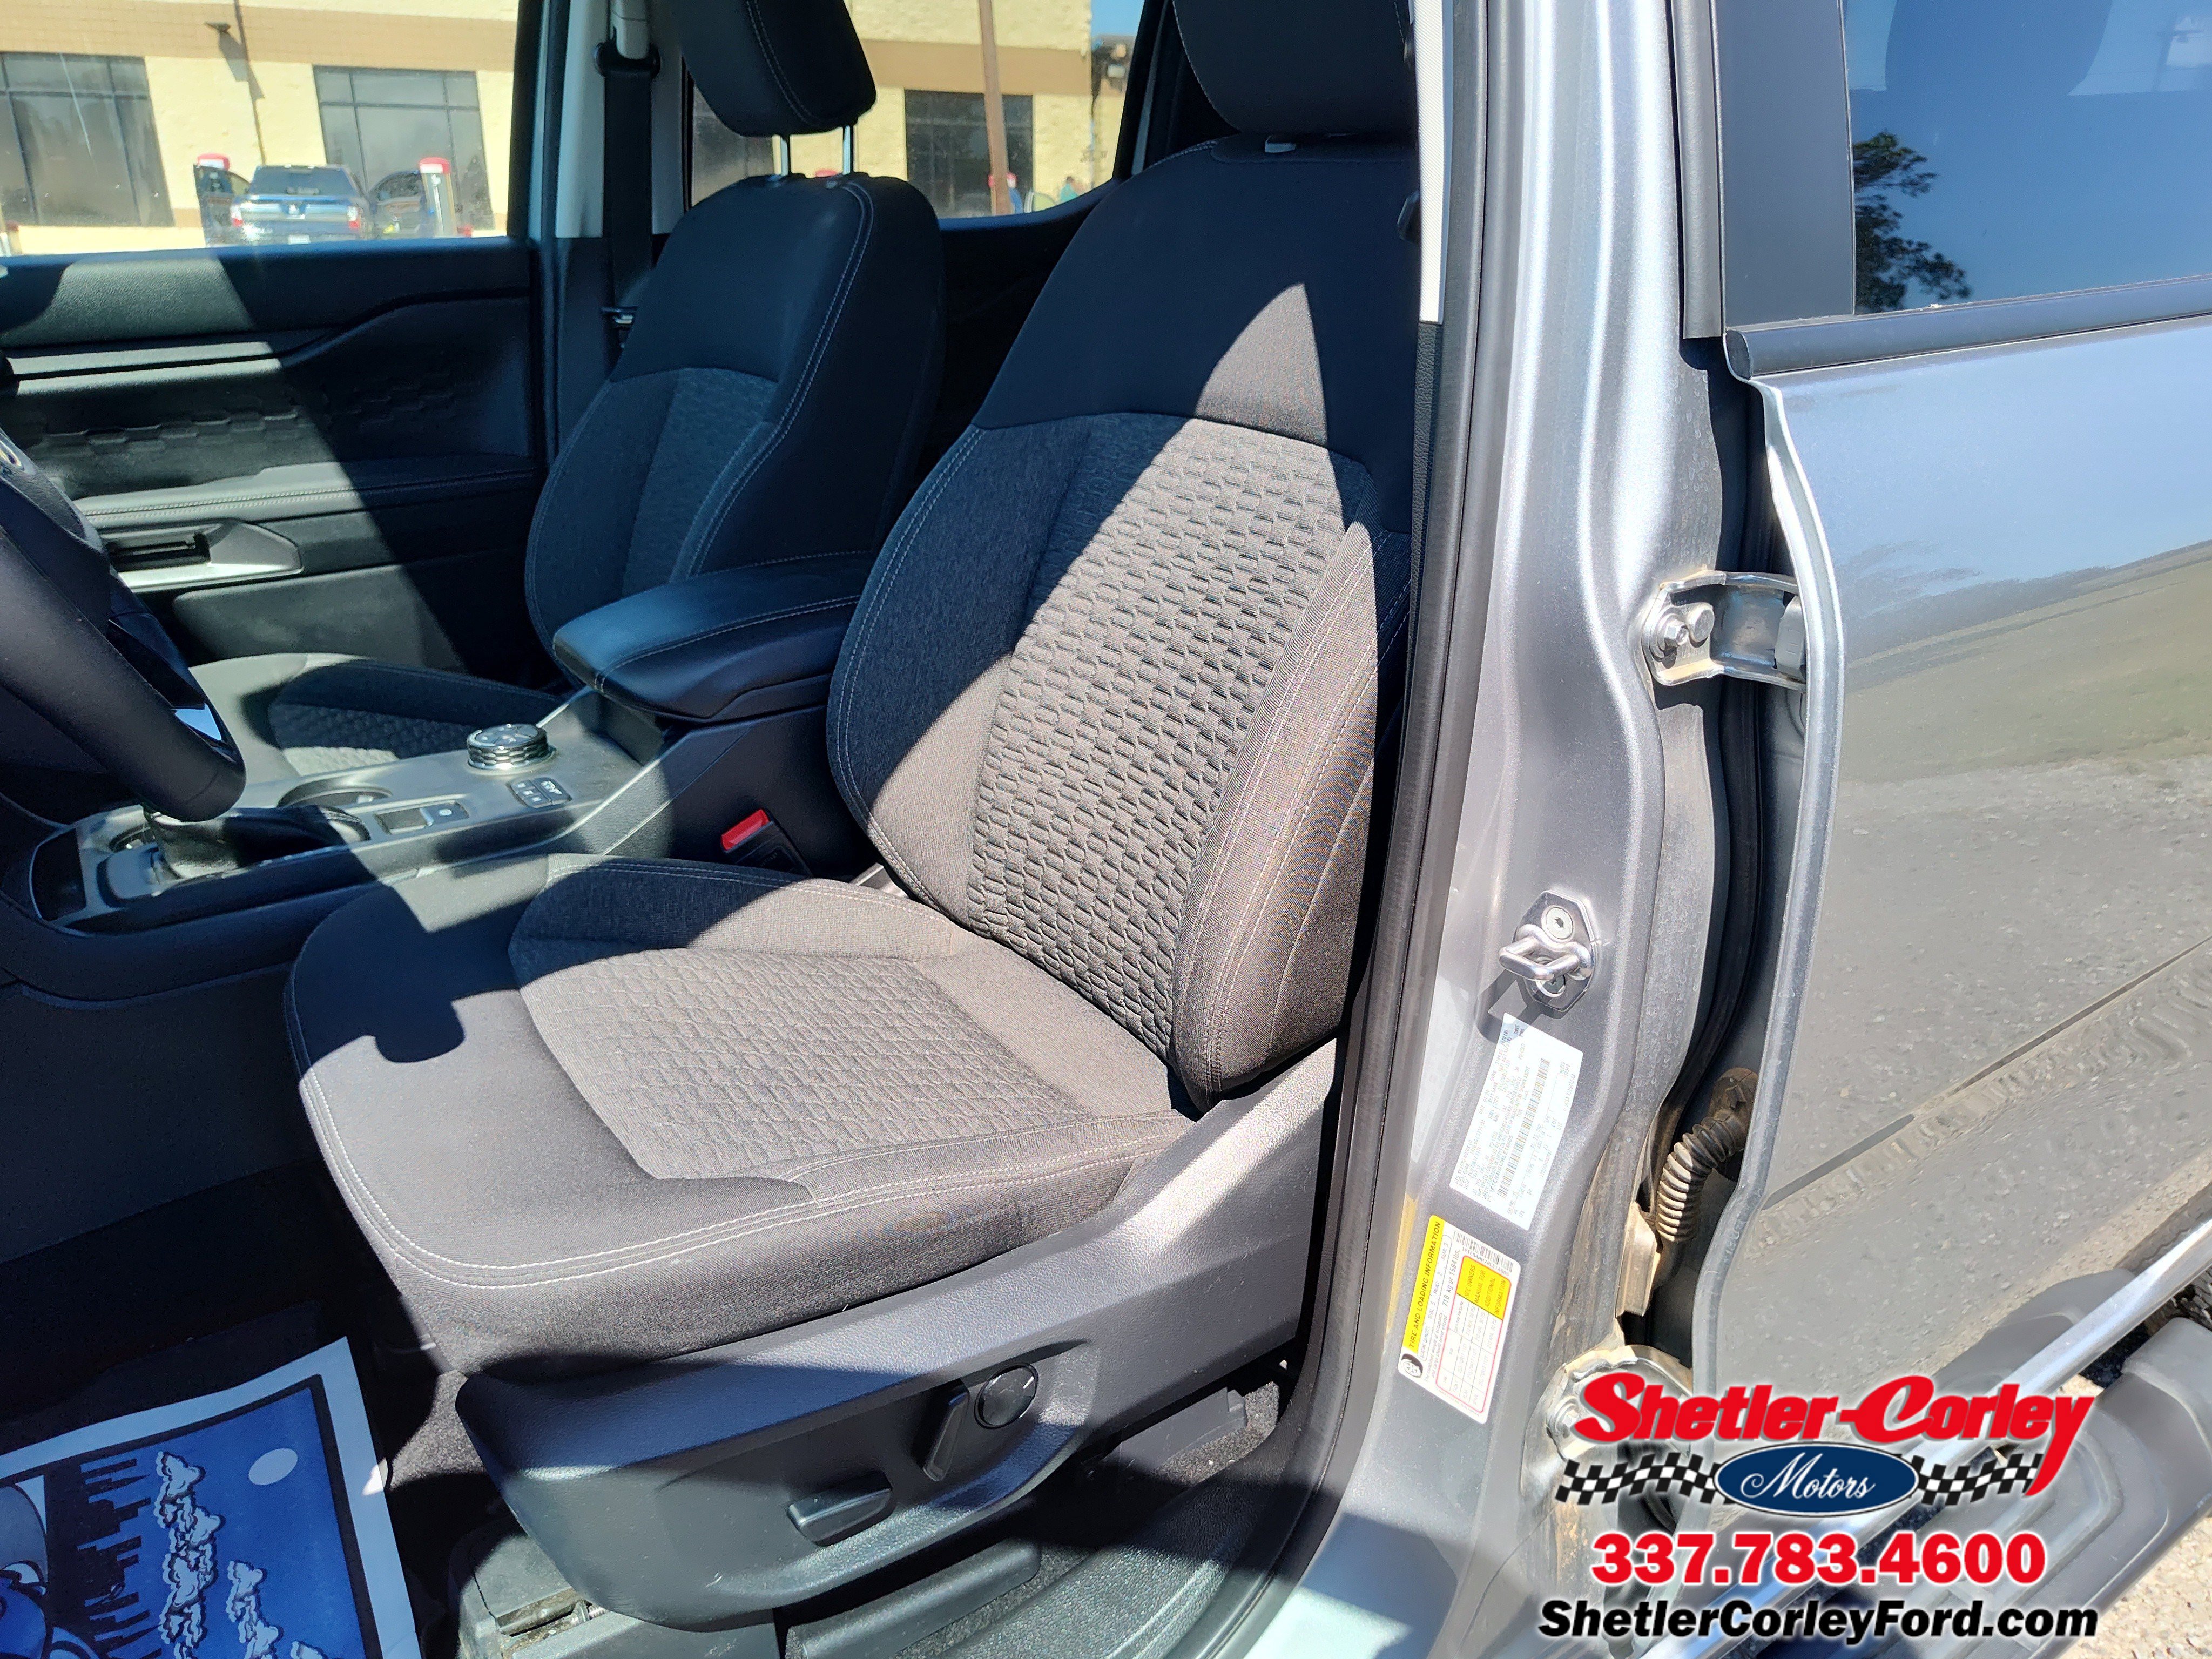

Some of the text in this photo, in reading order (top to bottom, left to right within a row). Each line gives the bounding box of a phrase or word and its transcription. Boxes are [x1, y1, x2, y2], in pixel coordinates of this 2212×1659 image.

[1522, 1065, 1530, 1078] ABOVE
[1518, 1078, 1527, 1093] SHOWN
[1510, 1092, 1522, 1120] MANUFACTURE
[1480, 1172, 1488, 1189] VEHICLE
[1485, 1153, 1495, 1174] CONFORMS
[1496, 1120, 1507, 1142] APPLICABLE
[1503, 1104, 1512, 1121] FEDERAL
[1509, 1090, 1517, 1105] MOTOR
[1513, 1076, 1522, 1091] VEHICLE
[1462, 1145, 1471, 1159] MOTOR
[1486, 1165, 1496, 1187] STANDARDS
[1481, 1186, 1489, 1200] SAFETY
[1448, 1259, 1457, 1276] 1584
[1466, 1263, 1475, 1287] OWNERS
[1408, 1220, 1441, 1349] TIRE AND LOADING INFORMATION
[1445, 1283, 1453, 1293] kg
[1448, 1276, 1453, 1284] or
[1474, 1268, 1486, 1304] MANUAL FOR
[1441, 1293, 1449, 1307] 718
[1483, 1275, 1495, 1308] ADDITIONAL
[1493, 1278, 1506, 1316] INFORMATION
[1426, 1353, 1434, 1374] combined
